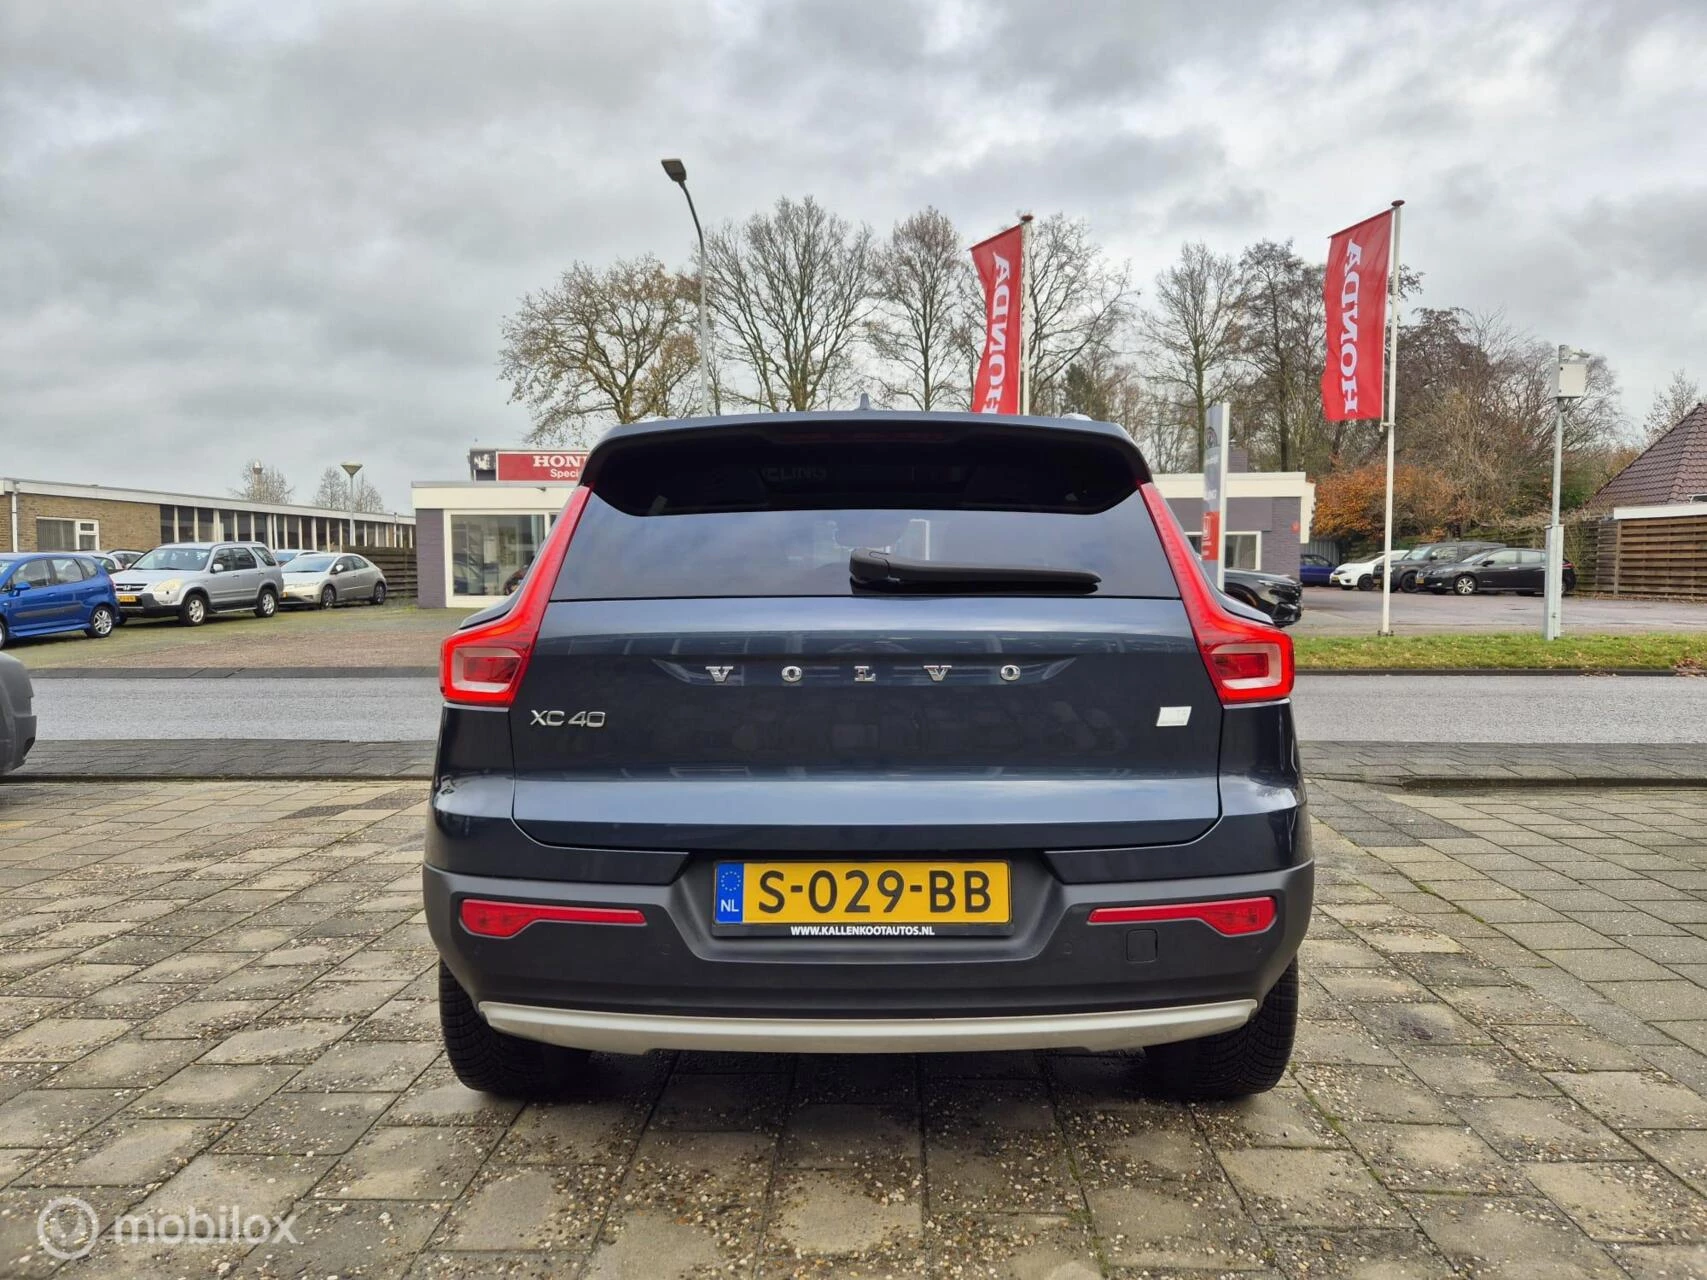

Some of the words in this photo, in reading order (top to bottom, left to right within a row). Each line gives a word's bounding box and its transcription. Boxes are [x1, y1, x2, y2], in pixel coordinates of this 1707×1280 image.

[982, 252, 1011, 414] HONDA
[1340, 239, 1362, 414] HONDA
[705, 664, 1022, 683] VOLVO
[720, 899, 740, 913] NL
[758, 870, 992, 914] S-029-BB
[790, 925, 936, 937] WWW.KALLENKOOTAUTOS.NL
